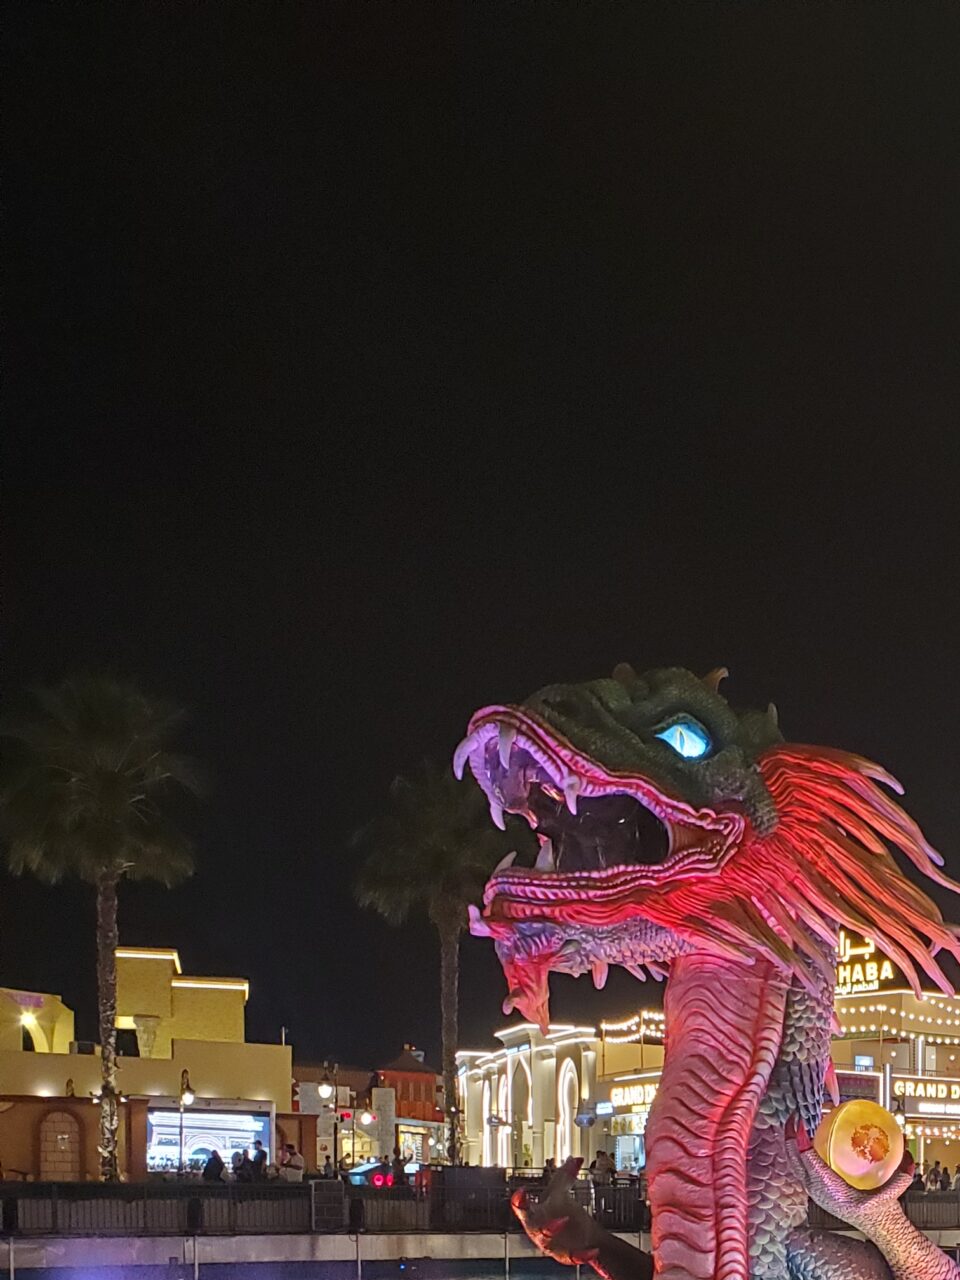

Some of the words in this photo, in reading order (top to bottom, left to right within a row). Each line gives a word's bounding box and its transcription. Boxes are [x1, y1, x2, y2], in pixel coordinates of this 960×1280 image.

[835, 960, 894, 984] HABA
[611, 1085, 644, 1107] GRAND
[894, 1080, 948, 1098] GRAND
